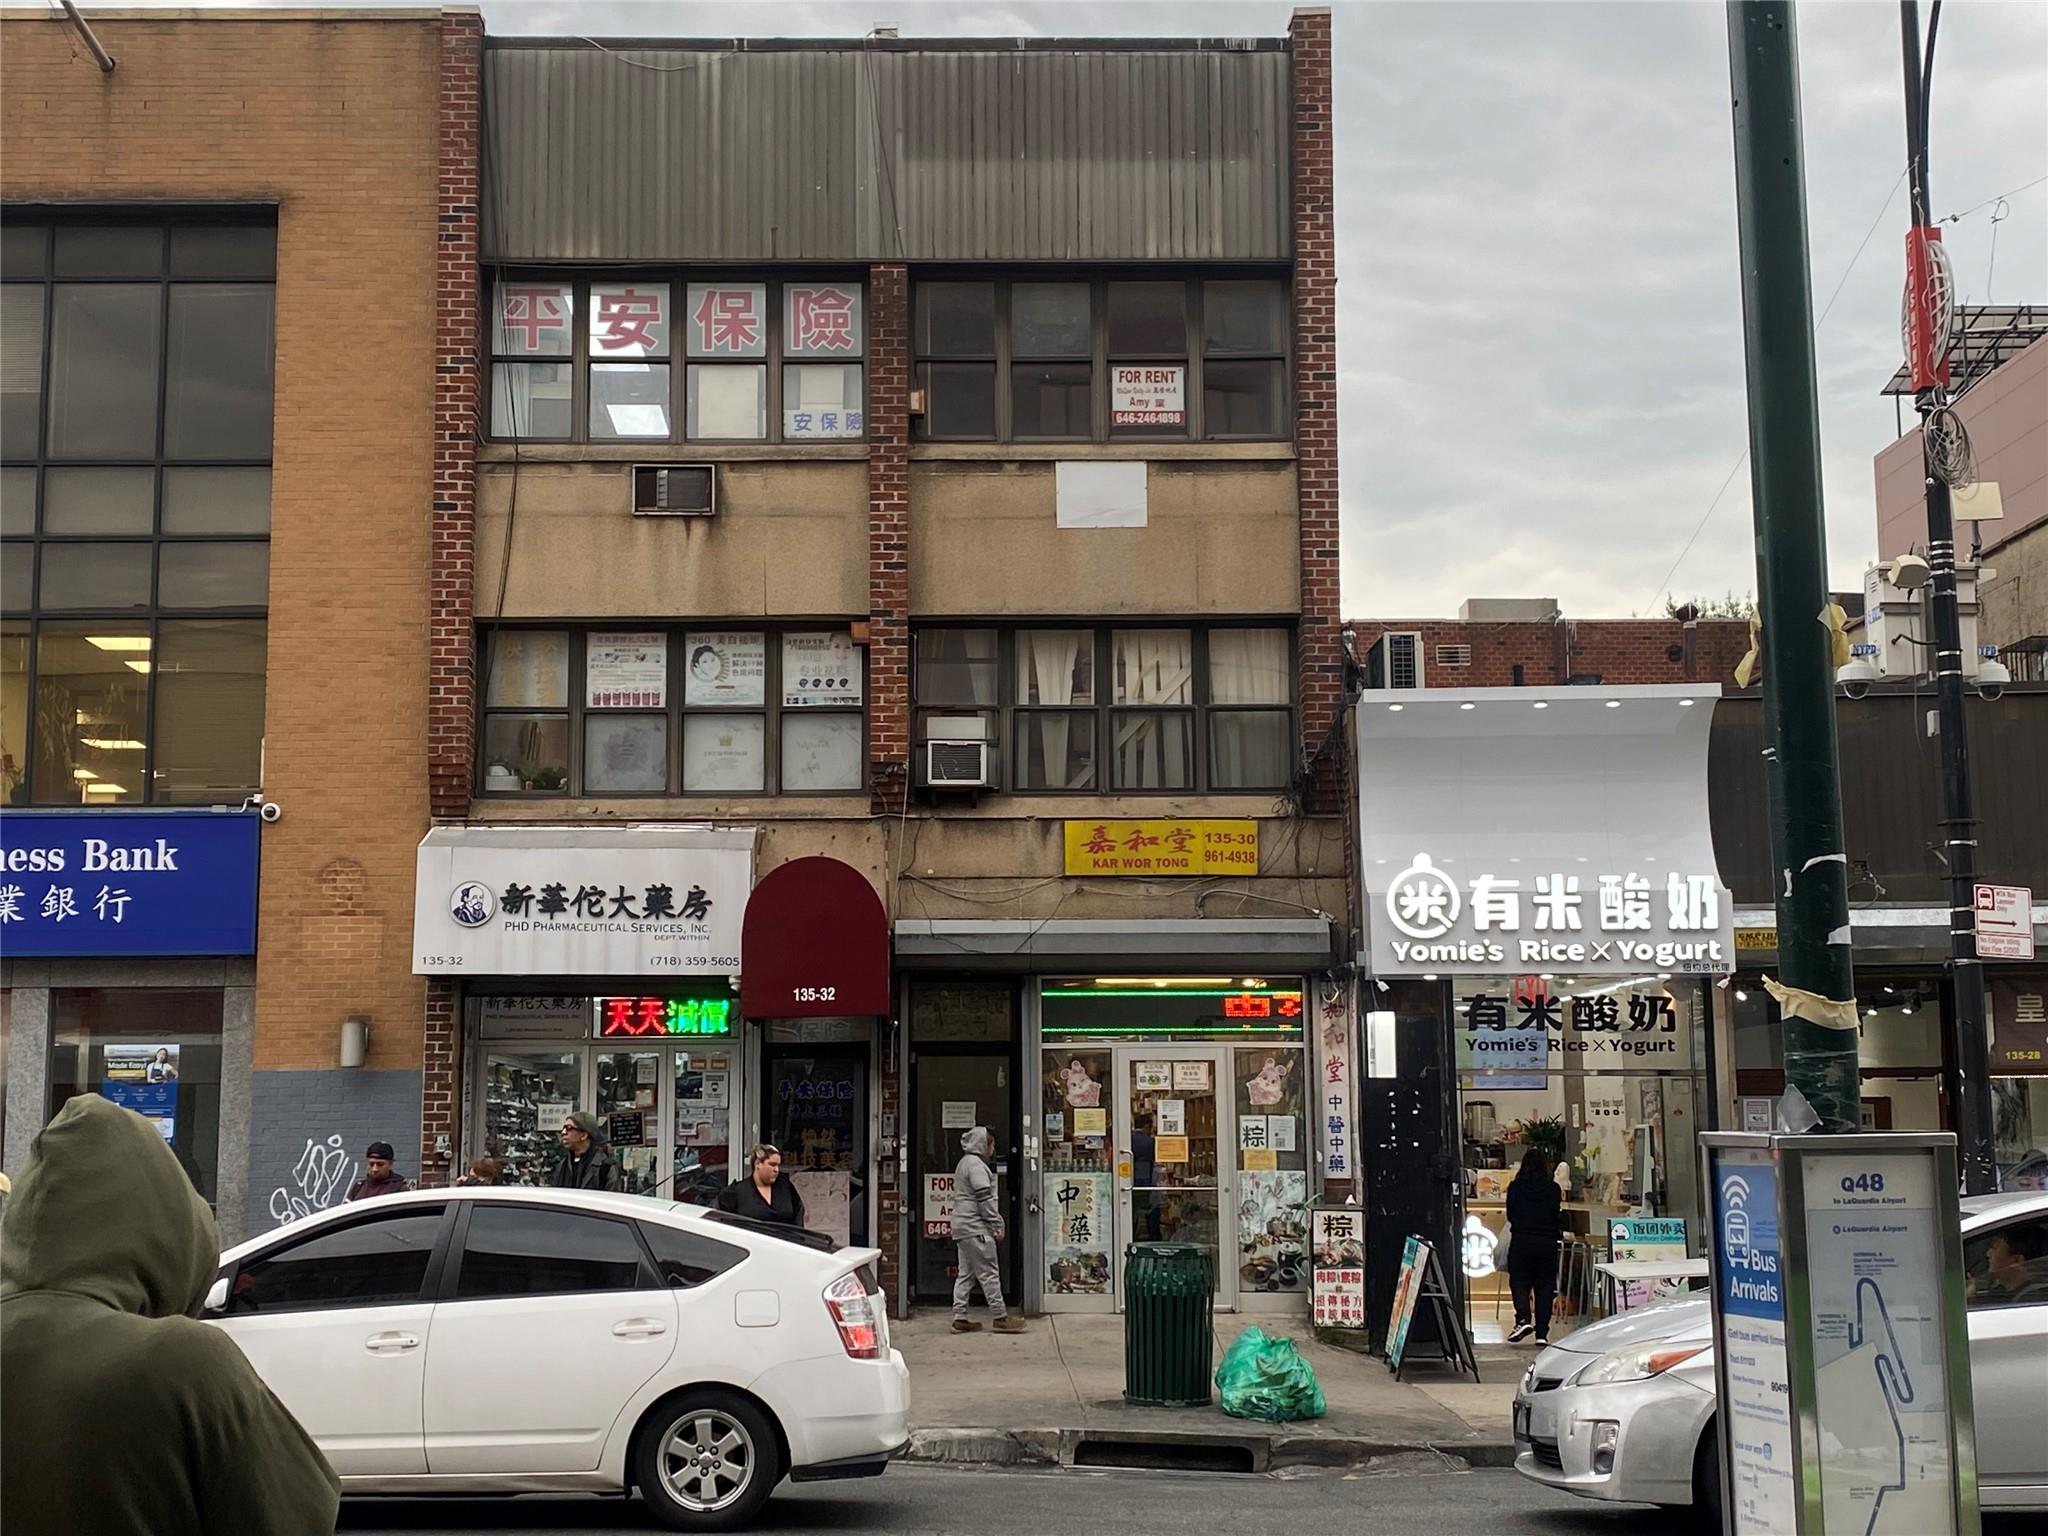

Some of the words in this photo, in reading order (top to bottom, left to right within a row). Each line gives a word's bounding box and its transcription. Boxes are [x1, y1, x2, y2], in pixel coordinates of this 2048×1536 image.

[504, 288, 855, 351] 平安保險
[1119, 370, 1141, 383] FOR
[1145, 370, 1176, 383] RENT
[1129, 397, 1149, 408] Amy
[1852, 644, 1876, 654] NYPD
[1080, 825, 1196, 854] 嘉和堂
[1204, 833, 1256, 845] 135-30
[81, 839, 179, 871] Bank
[1093, 859, 1118, 868] KAR
[1123, 859, 1152, 868] WOR
[1156, 859, 1189, 868] TONG
[1204, 851, 1255, 863] 961-4938
[500, 882, 713, 920] 新華佗大藥房
[1469, 872, 1719, 930] 有米酸奶
[504, 922, 529, 932] PHD
[422, 956, 463, 966] 135-32
[650, 956, 681, 967] (718)
[685, 956, 740, 967] 359-5605
[1390, 939, 1504, 963] Yomie's
[1518, 939, 1586, 962] Rice
[1614, 939, 1722, 967] Yogurt
[793, 987, 836, 1001] 135-32
[1462, 994, 1677, 1032] 有米酸奶
[1465, 1037, 1538, 1051] Yomie's
[1548, 1038, 1588, 1052] Rice
[1609, 1038, 1676, 1056] Yogurt
[1242, 1125, 1265, 1148] 粽
[931, 1177, 955, 1191] FOR
[1841, 1173, 1884, 1192] Q48
[1056, 1180, 1092, 1243] 中藥
[1323, 1215, 1353, 1238] 粽
[1751, 1249, 1776, 1272] Bus
[1731, 1276, 1778, 1302] Arrivals
